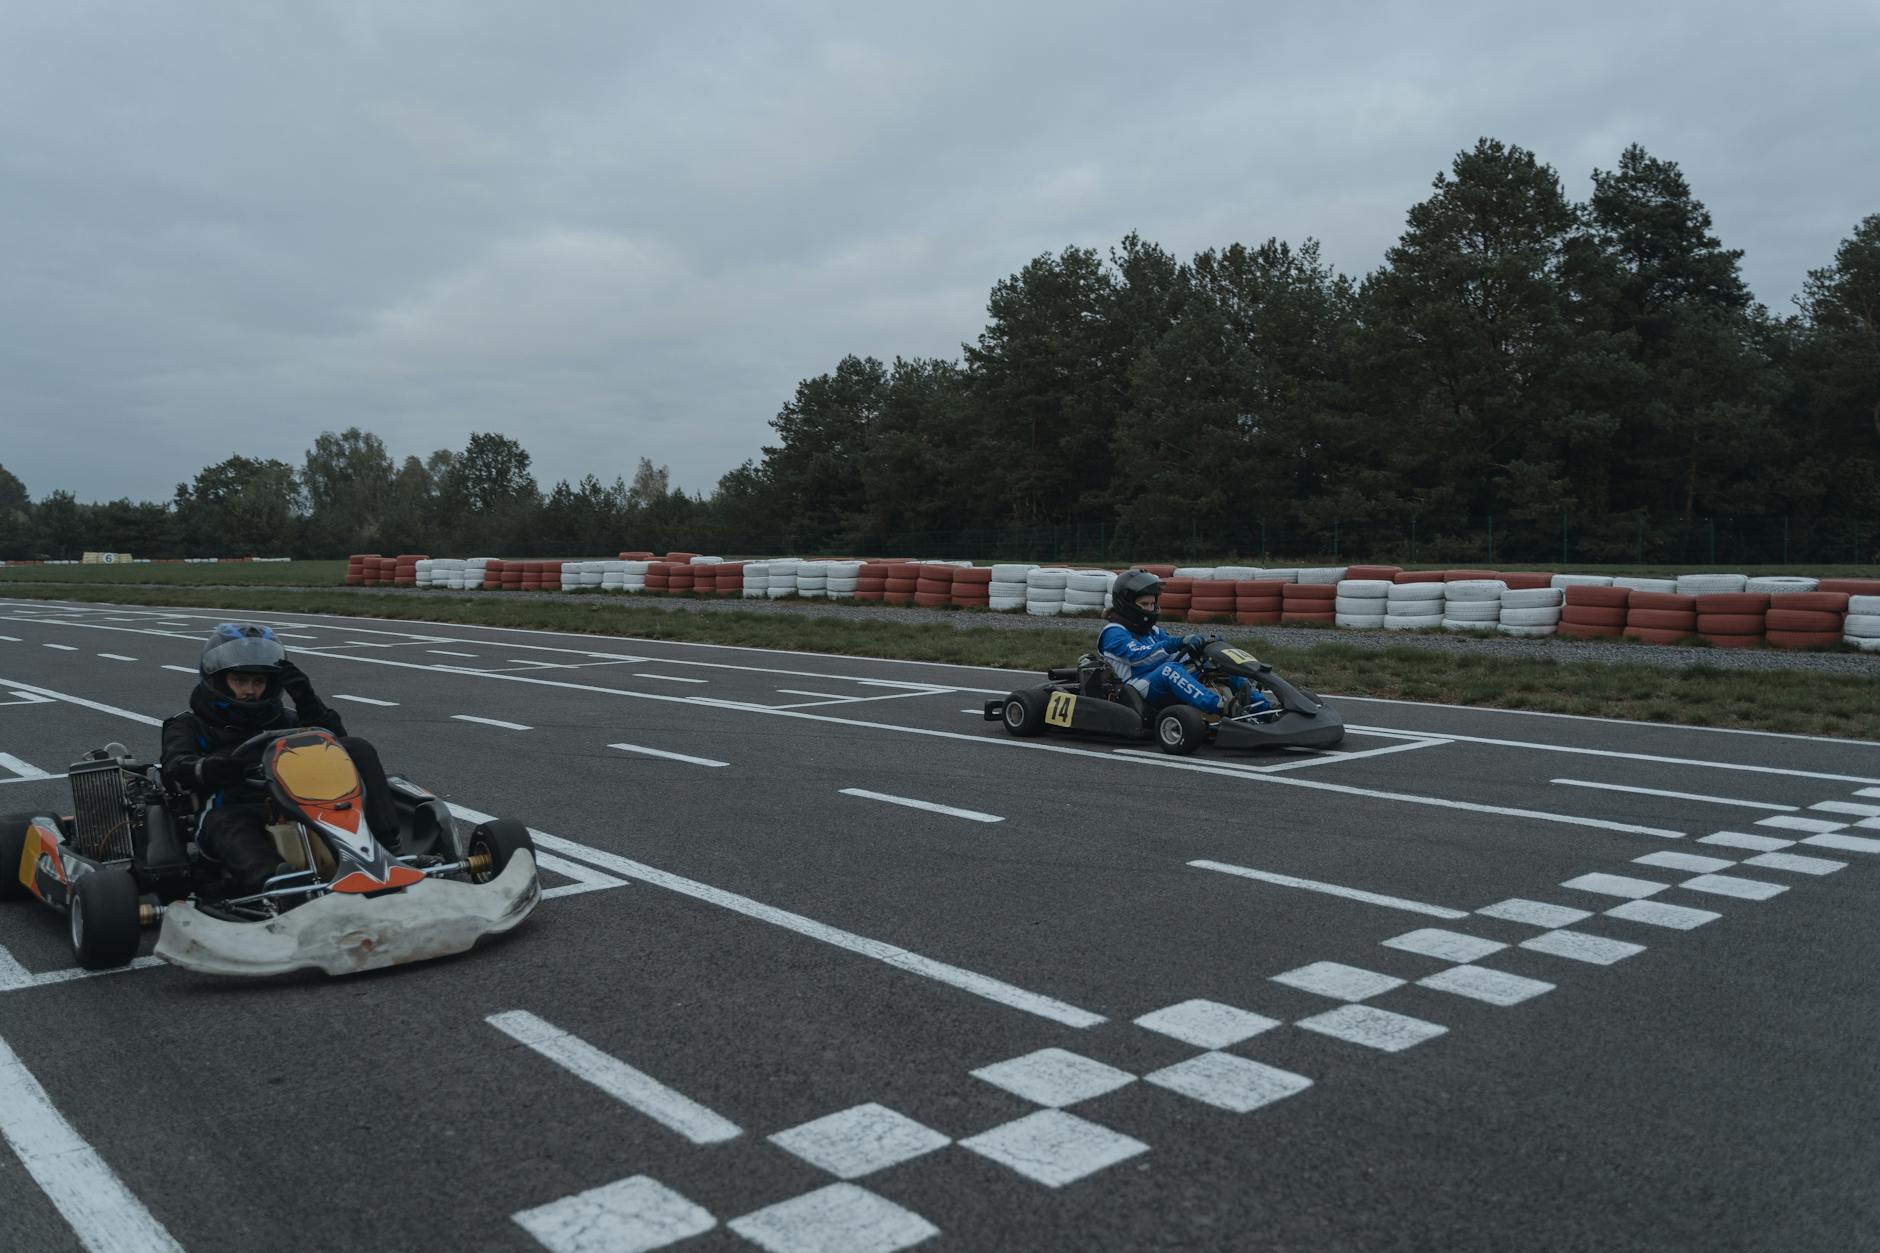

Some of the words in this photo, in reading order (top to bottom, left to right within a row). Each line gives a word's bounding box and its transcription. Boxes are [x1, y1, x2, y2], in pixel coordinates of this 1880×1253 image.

[105, 554, 113, 563] 6
[1161, 665, 1205, 699] BREST
[1052, 695, 1071, 723] 14
